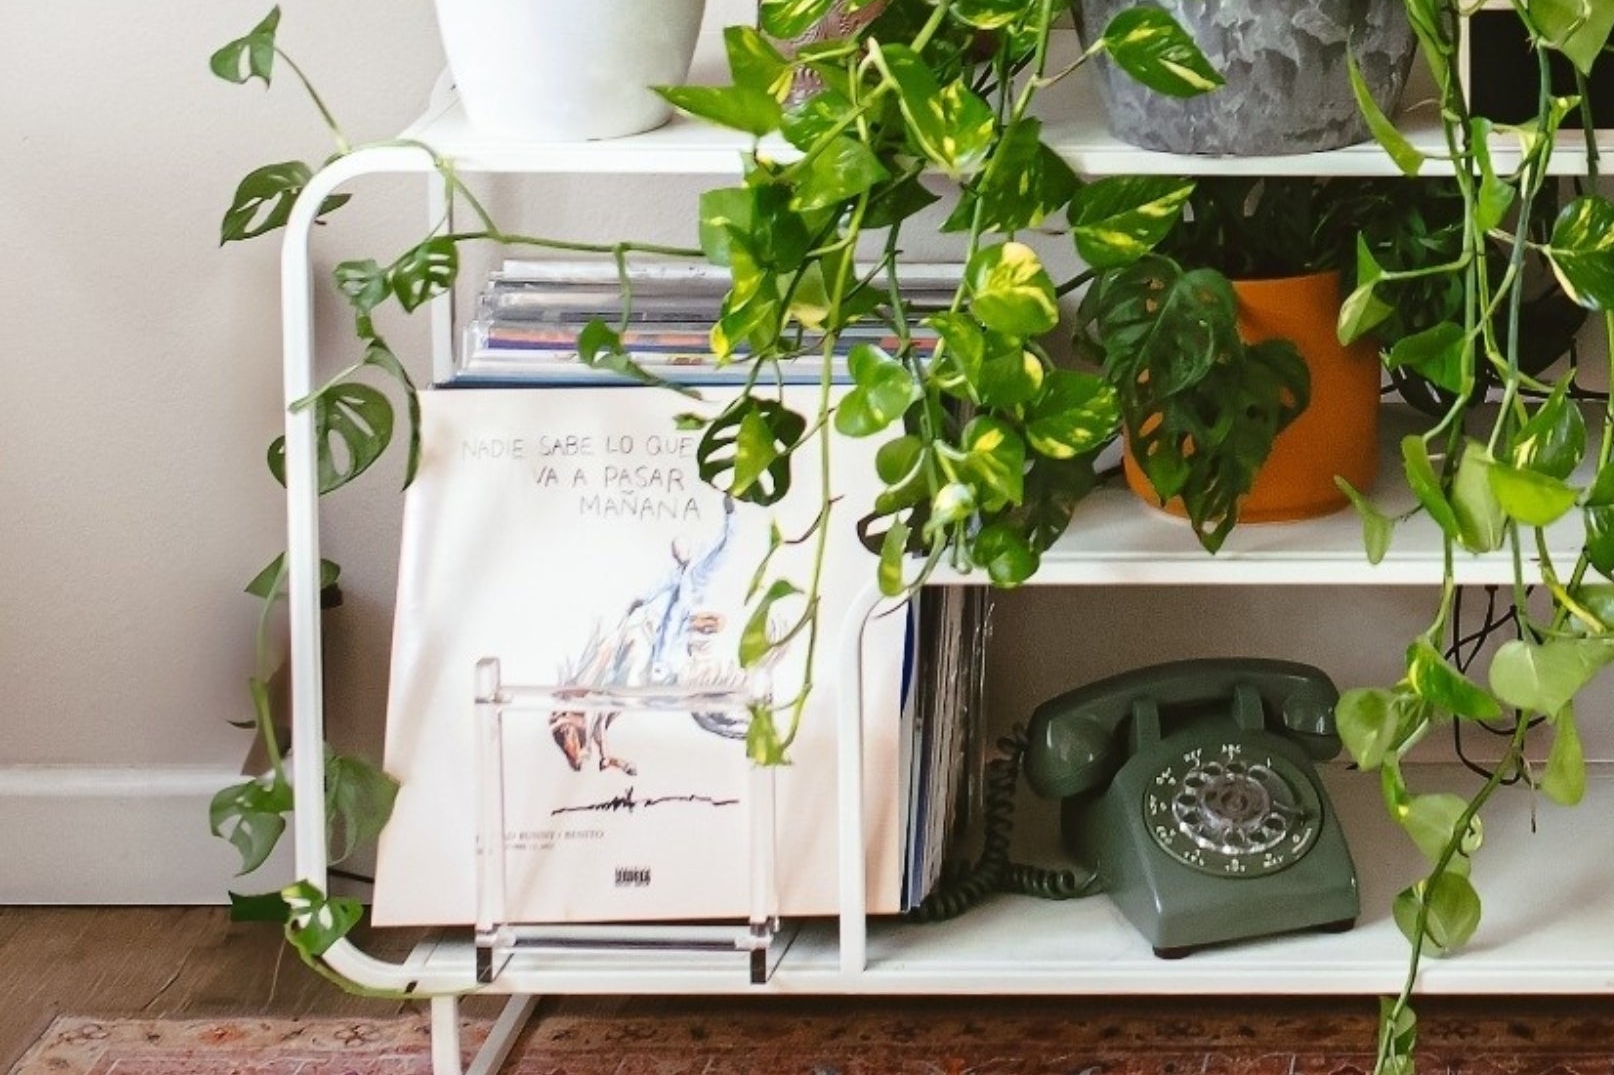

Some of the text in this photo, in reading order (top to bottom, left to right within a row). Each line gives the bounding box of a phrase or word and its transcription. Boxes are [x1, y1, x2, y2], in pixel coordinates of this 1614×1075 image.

[462, 435, 695, 460] NADIE SABE LO QUE
[572, 467, 588, 489] A
[604, 465, 685, 493] PASAR
[579, 490, 701, 521] MAÑANA
